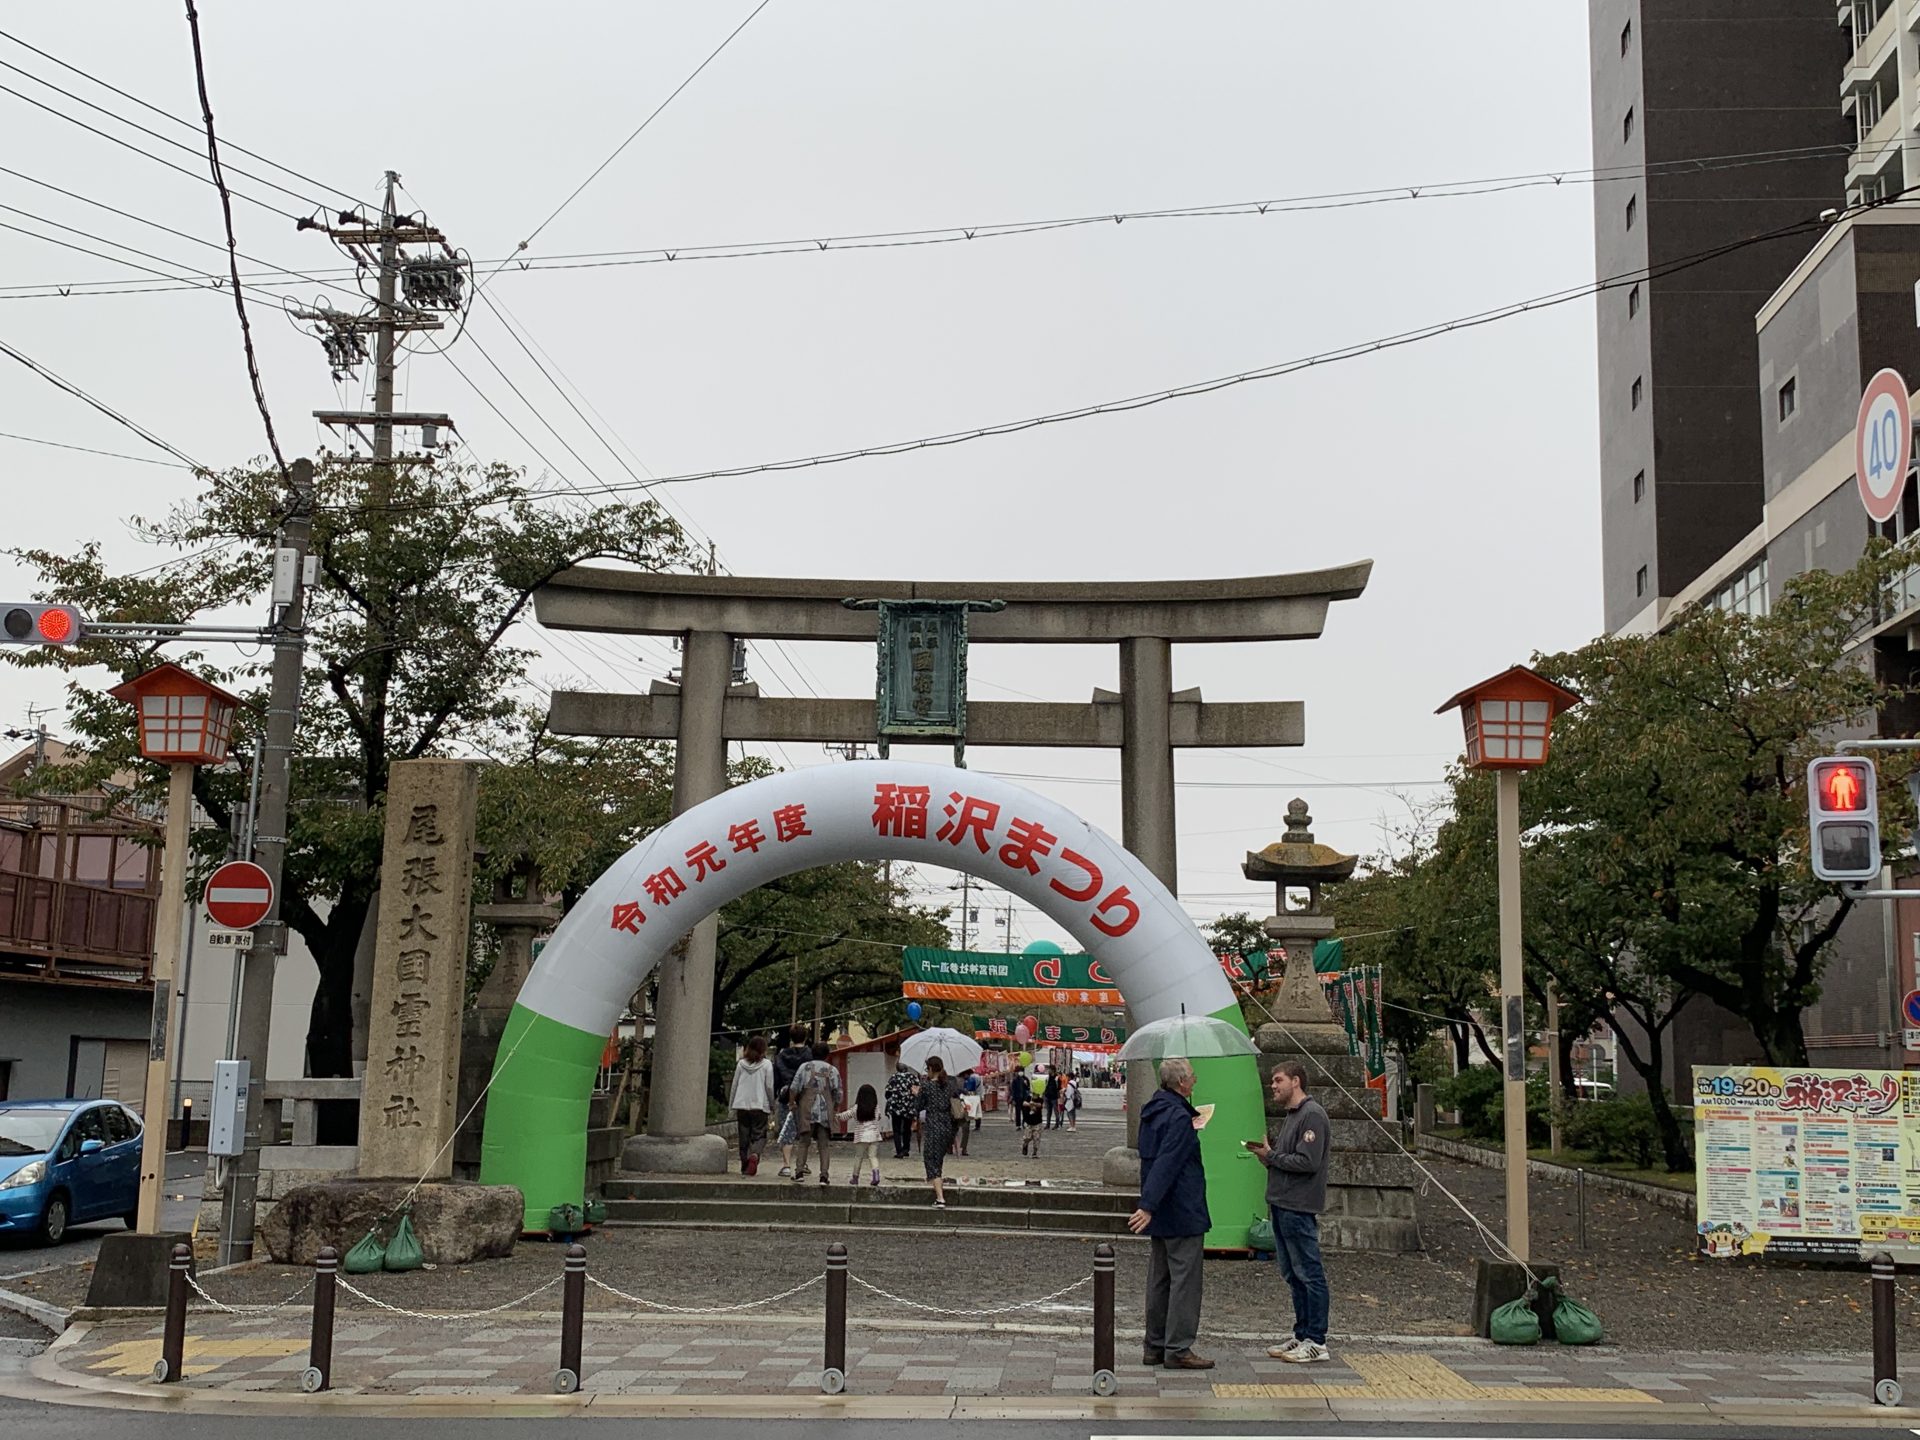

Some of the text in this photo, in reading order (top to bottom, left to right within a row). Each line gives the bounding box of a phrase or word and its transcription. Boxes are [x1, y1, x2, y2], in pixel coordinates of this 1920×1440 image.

[1869, 409, 1898, 479] 40
[610, 782, 1141, 938] 令和元年度 稲沢まつり
[1778, 1073, 1900, 1113] 稲沢まつり
